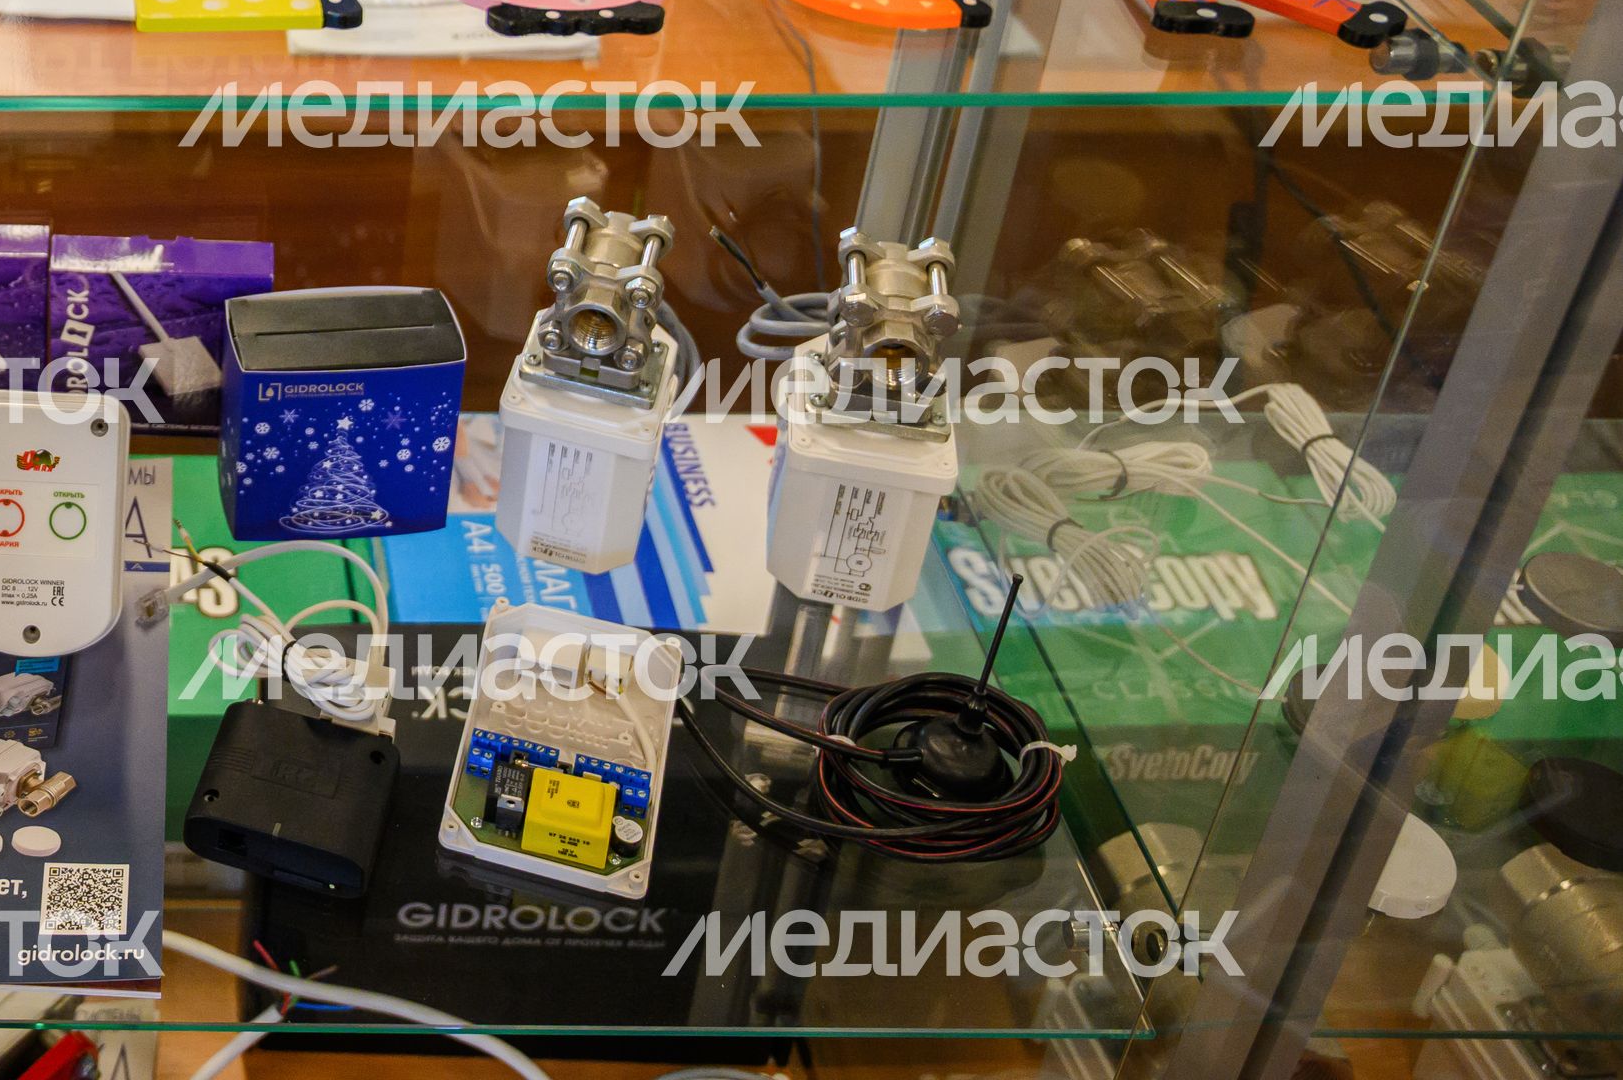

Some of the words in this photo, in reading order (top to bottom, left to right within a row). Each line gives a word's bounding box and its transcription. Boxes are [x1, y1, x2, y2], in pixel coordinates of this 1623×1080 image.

[284, 382, 364, 394] GIDROLOCK
[665, 423, 715, 507] BUSINESS
[53, 490, 85, 499] ОТКРЫТЬ
[2, 578, 39, 586] GIDROLOCK
[481, 563, 506, 595] 500
[397, 902, 666, 934] GIDROLOCK
[18, 944, 145, 965] gidrolock.ru
